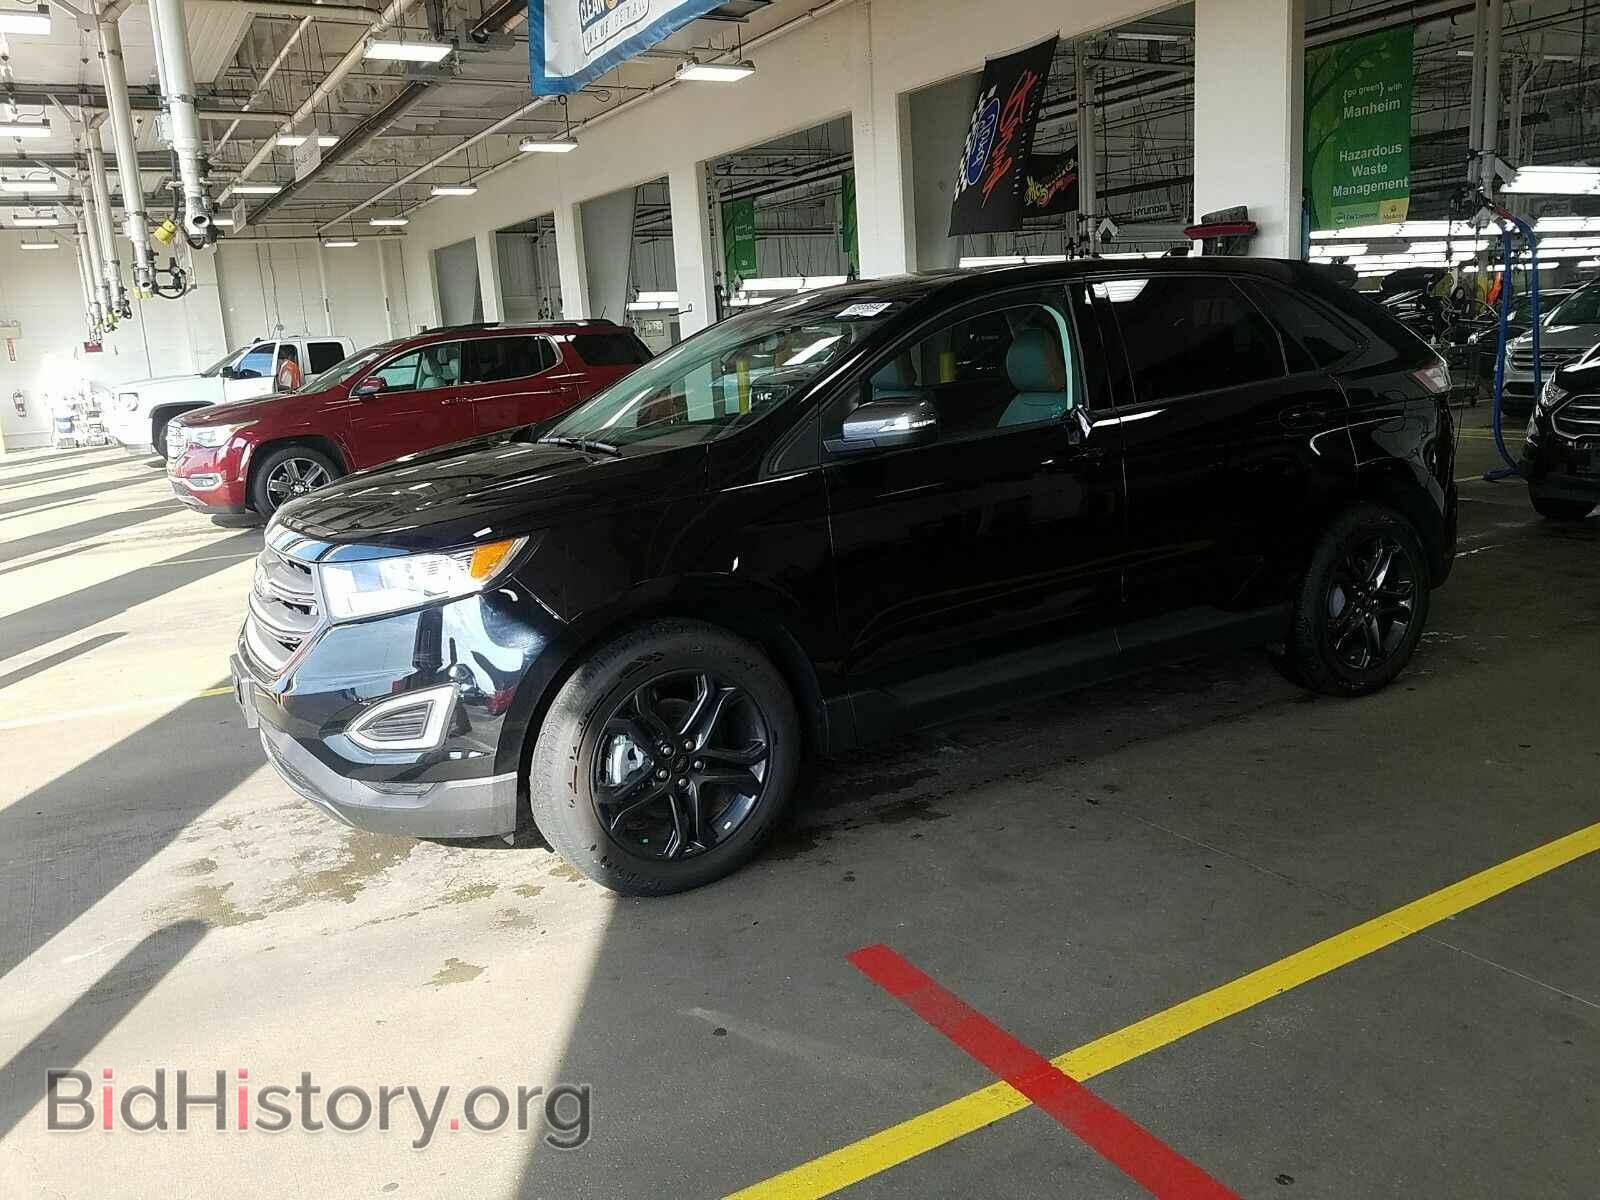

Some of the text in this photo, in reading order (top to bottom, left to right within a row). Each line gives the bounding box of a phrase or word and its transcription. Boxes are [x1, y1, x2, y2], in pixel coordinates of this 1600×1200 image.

[1343, 99, 1401, 119] Manheim
[1340, 143, 1402, 162] Hazardous
[1351, 163, 1388, 177] Waste
[1332, 176, 1409, 197] Management
